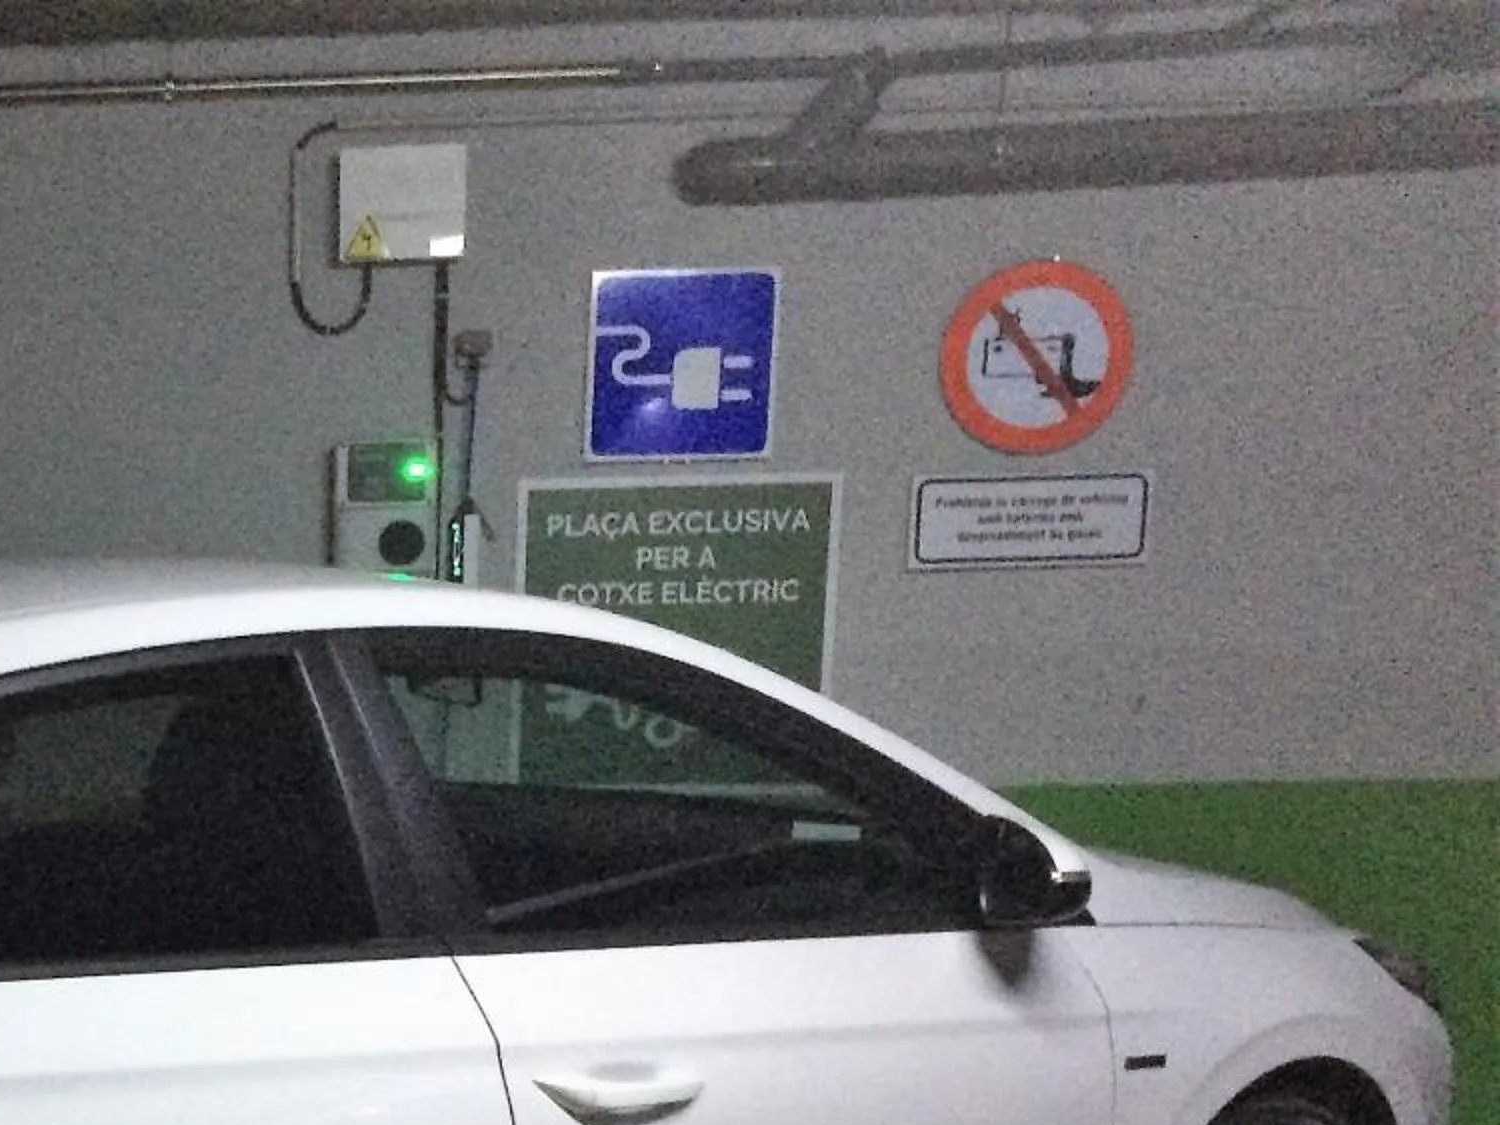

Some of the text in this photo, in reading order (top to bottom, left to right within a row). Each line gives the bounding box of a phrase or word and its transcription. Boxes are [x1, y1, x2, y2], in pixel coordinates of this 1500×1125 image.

[547, 507, 811, 540] PLAÇA EXCLUSIVA
[636, 545, 716, 570] PER A
[557, 582, 653, 605] COTXE
